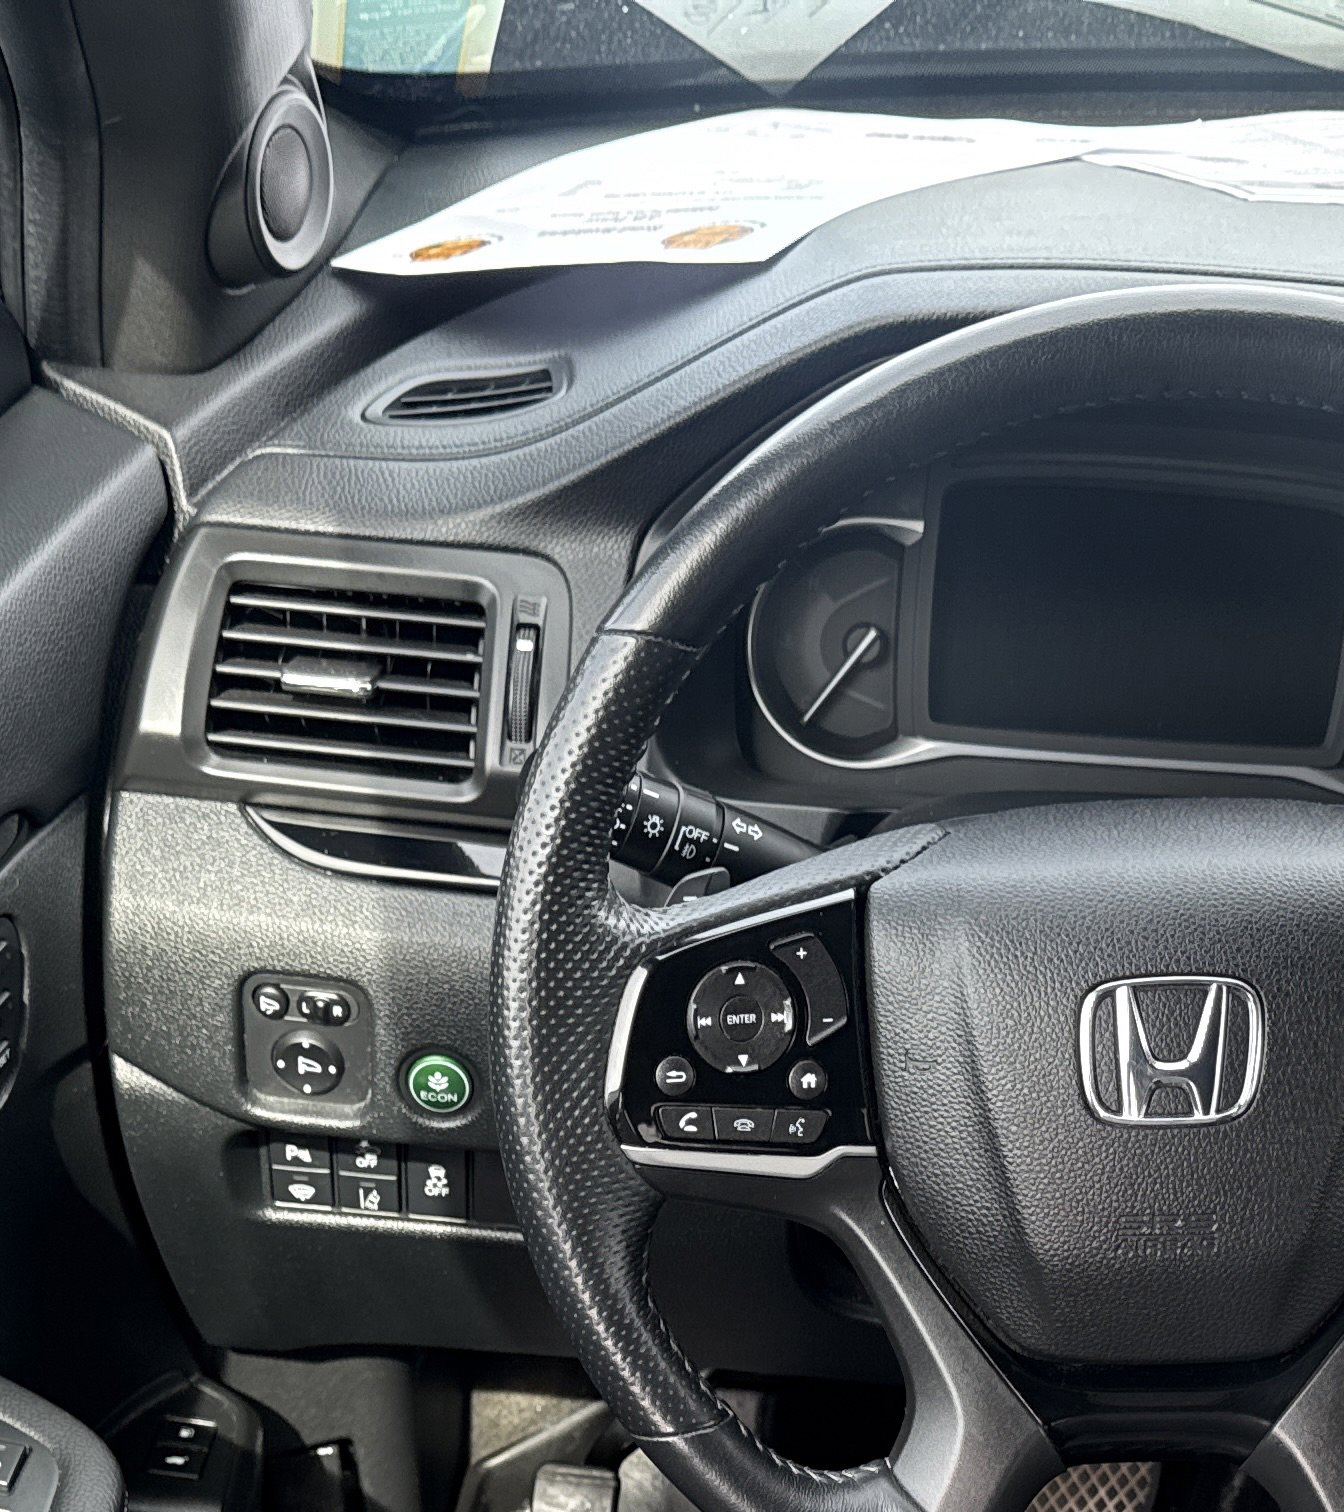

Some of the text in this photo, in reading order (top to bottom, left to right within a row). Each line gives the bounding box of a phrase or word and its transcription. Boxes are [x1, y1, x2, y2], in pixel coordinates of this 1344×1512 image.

[686, 825, 709, 842] OFF
[332, 1005, 343, 1017] R
[726, 1013, 757, 1026] ENTER
[419, 1090, 458, 1103] ECON
